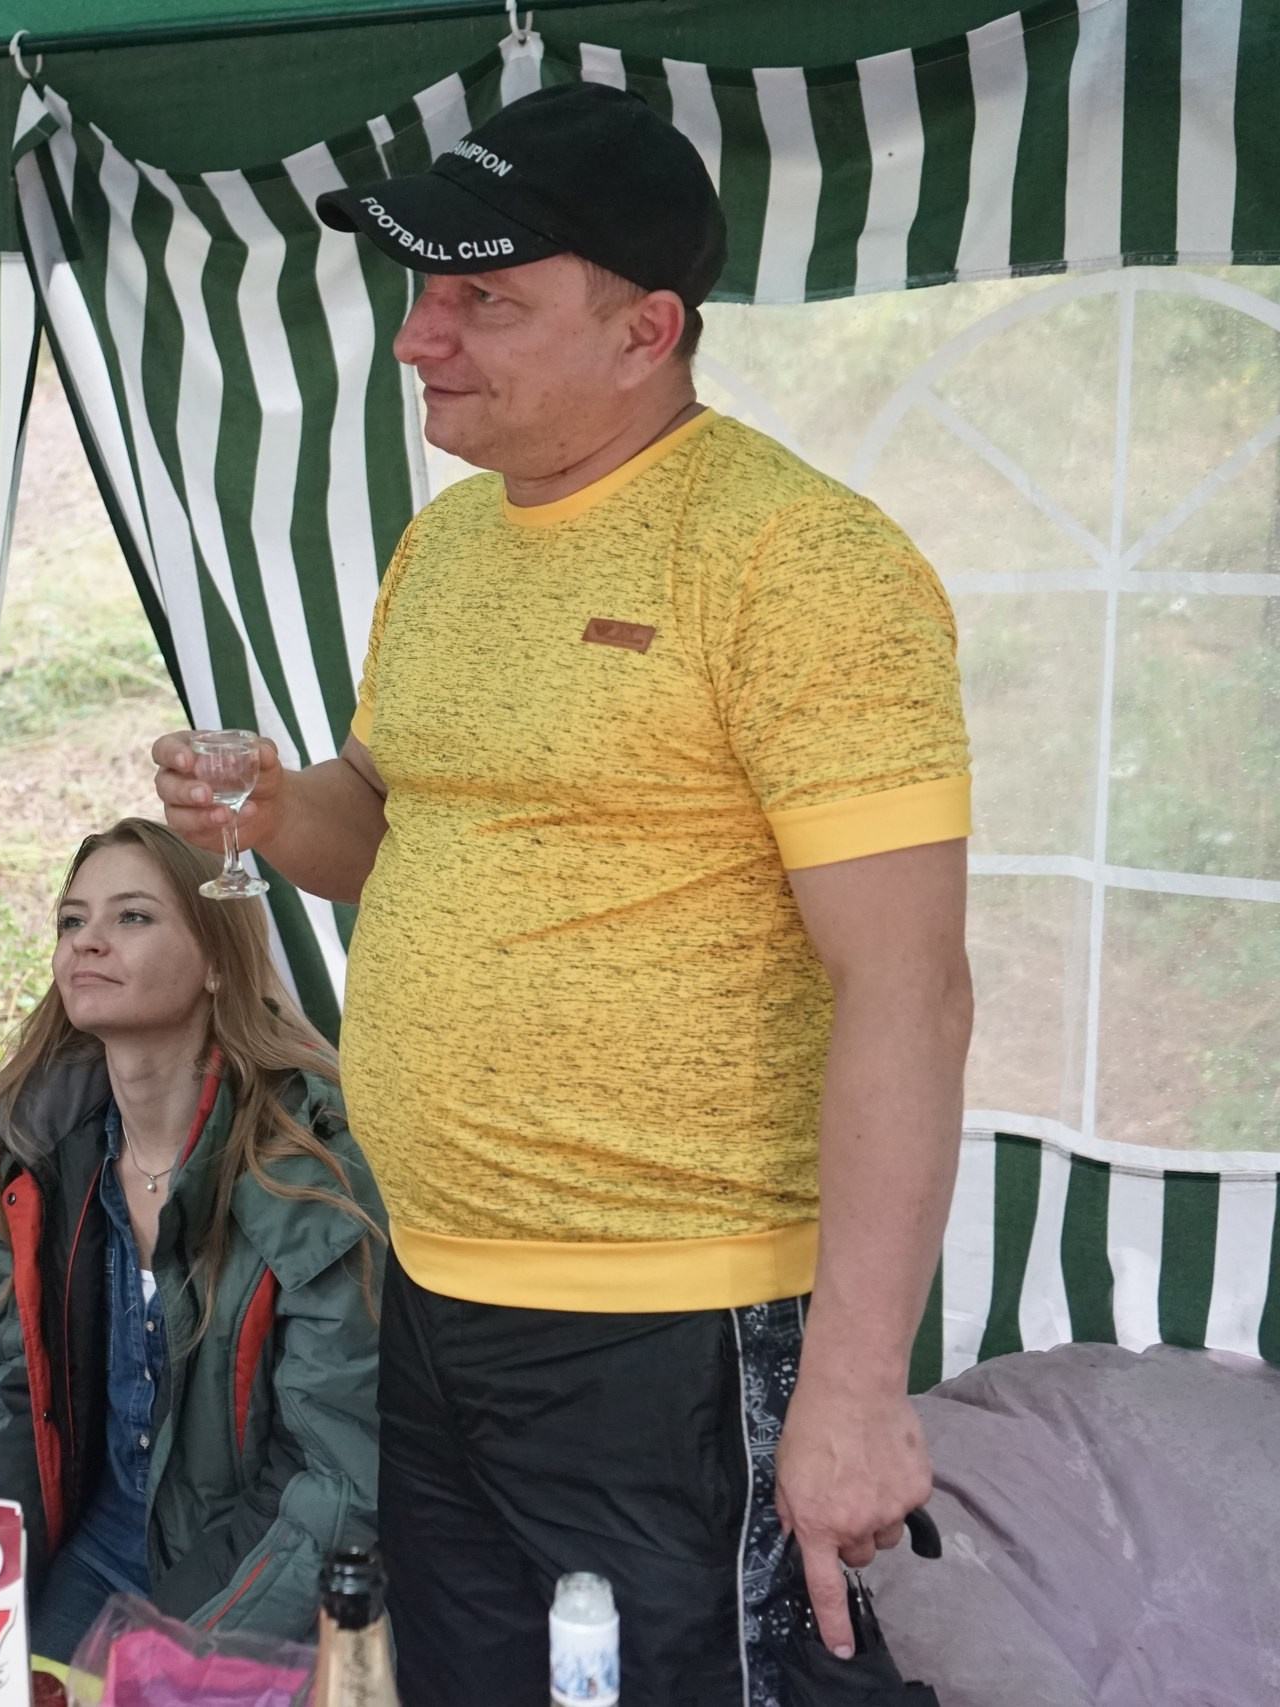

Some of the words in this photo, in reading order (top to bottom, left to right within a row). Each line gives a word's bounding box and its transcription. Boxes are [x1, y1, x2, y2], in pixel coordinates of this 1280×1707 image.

[453, 140, 514, 177] AMPION
[360, 196, 452, 261] FOOTBALL
[458, 237, 515, 260] CLUB
